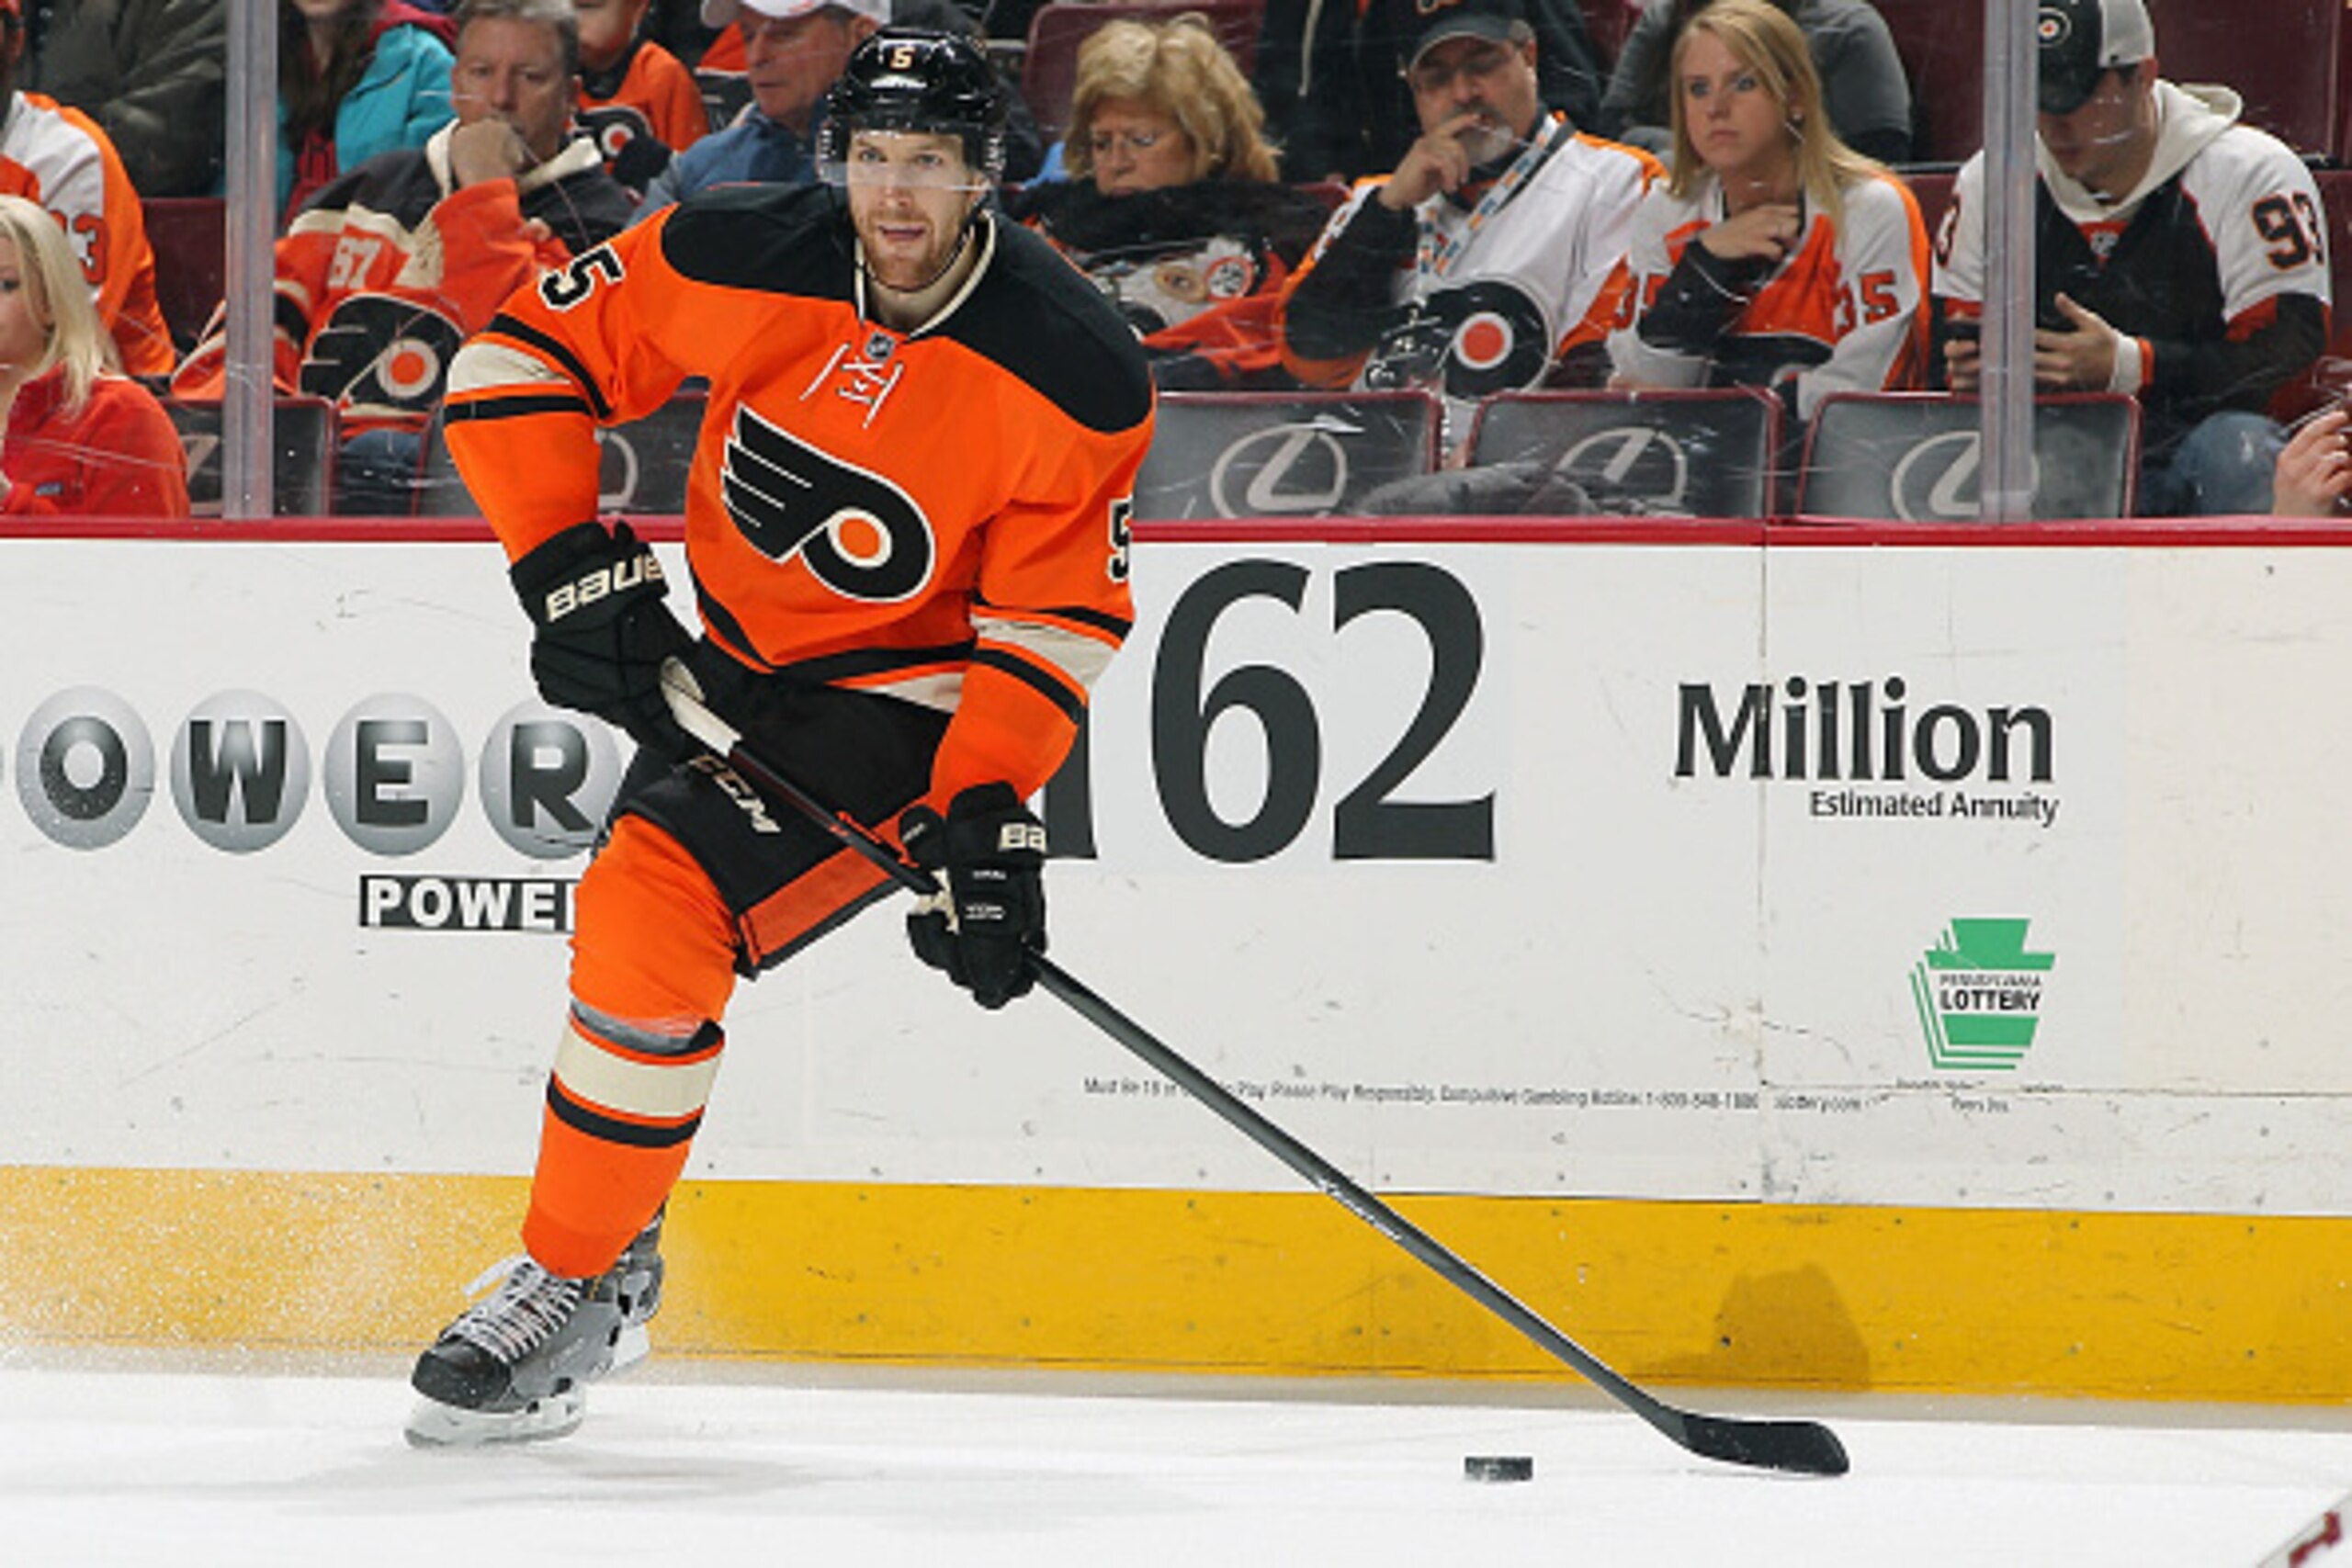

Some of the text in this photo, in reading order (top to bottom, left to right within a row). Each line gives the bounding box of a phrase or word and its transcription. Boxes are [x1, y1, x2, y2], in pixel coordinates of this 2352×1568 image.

[889, 46, 916, 70] 5
[537, 242, 627, 312] 5
[1675, 675, 2054, 783] Million
[1810, 790, 2059, 827] Estimated Annuity
[368, 878, 578, 929] POWE
[1939, 989, 2041, 1010] LOTTERY
